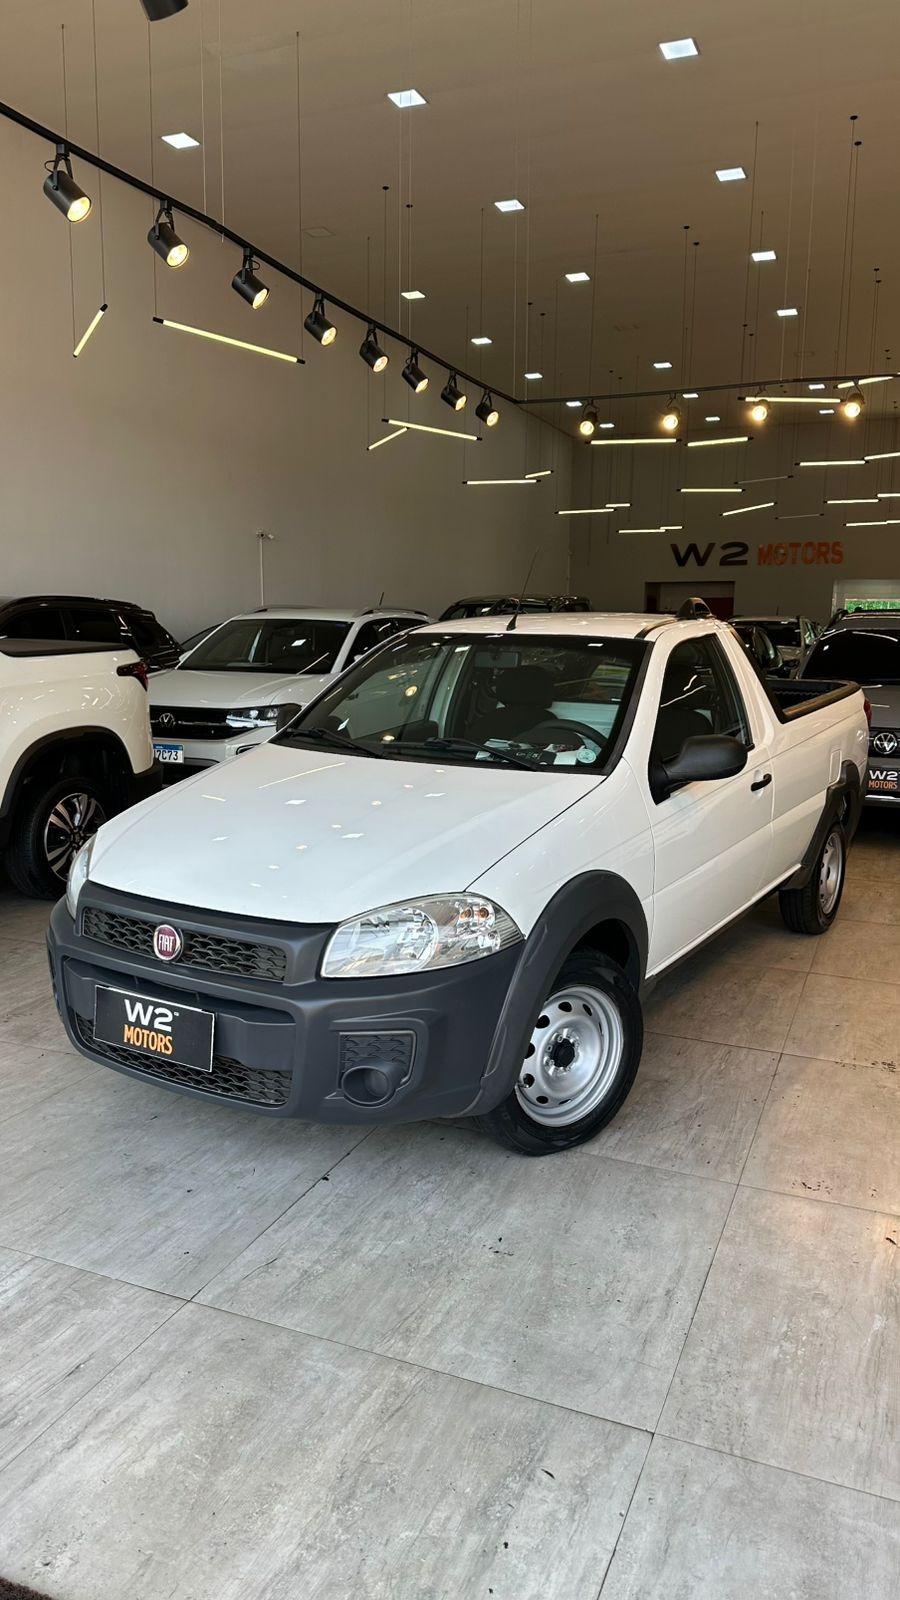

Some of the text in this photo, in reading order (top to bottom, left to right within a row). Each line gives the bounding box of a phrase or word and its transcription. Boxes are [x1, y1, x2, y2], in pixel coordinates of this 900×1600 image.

[670, 541, 844, 567] W2 MOTORS
[868, 769, 898, 781] W2
[868, 780, 898, 789] MOTORS
[158, 934, 175, 952] FIAT
[124, 998, 174, 1032] W2
[123, 1024, 173, 1055] MOTORS
